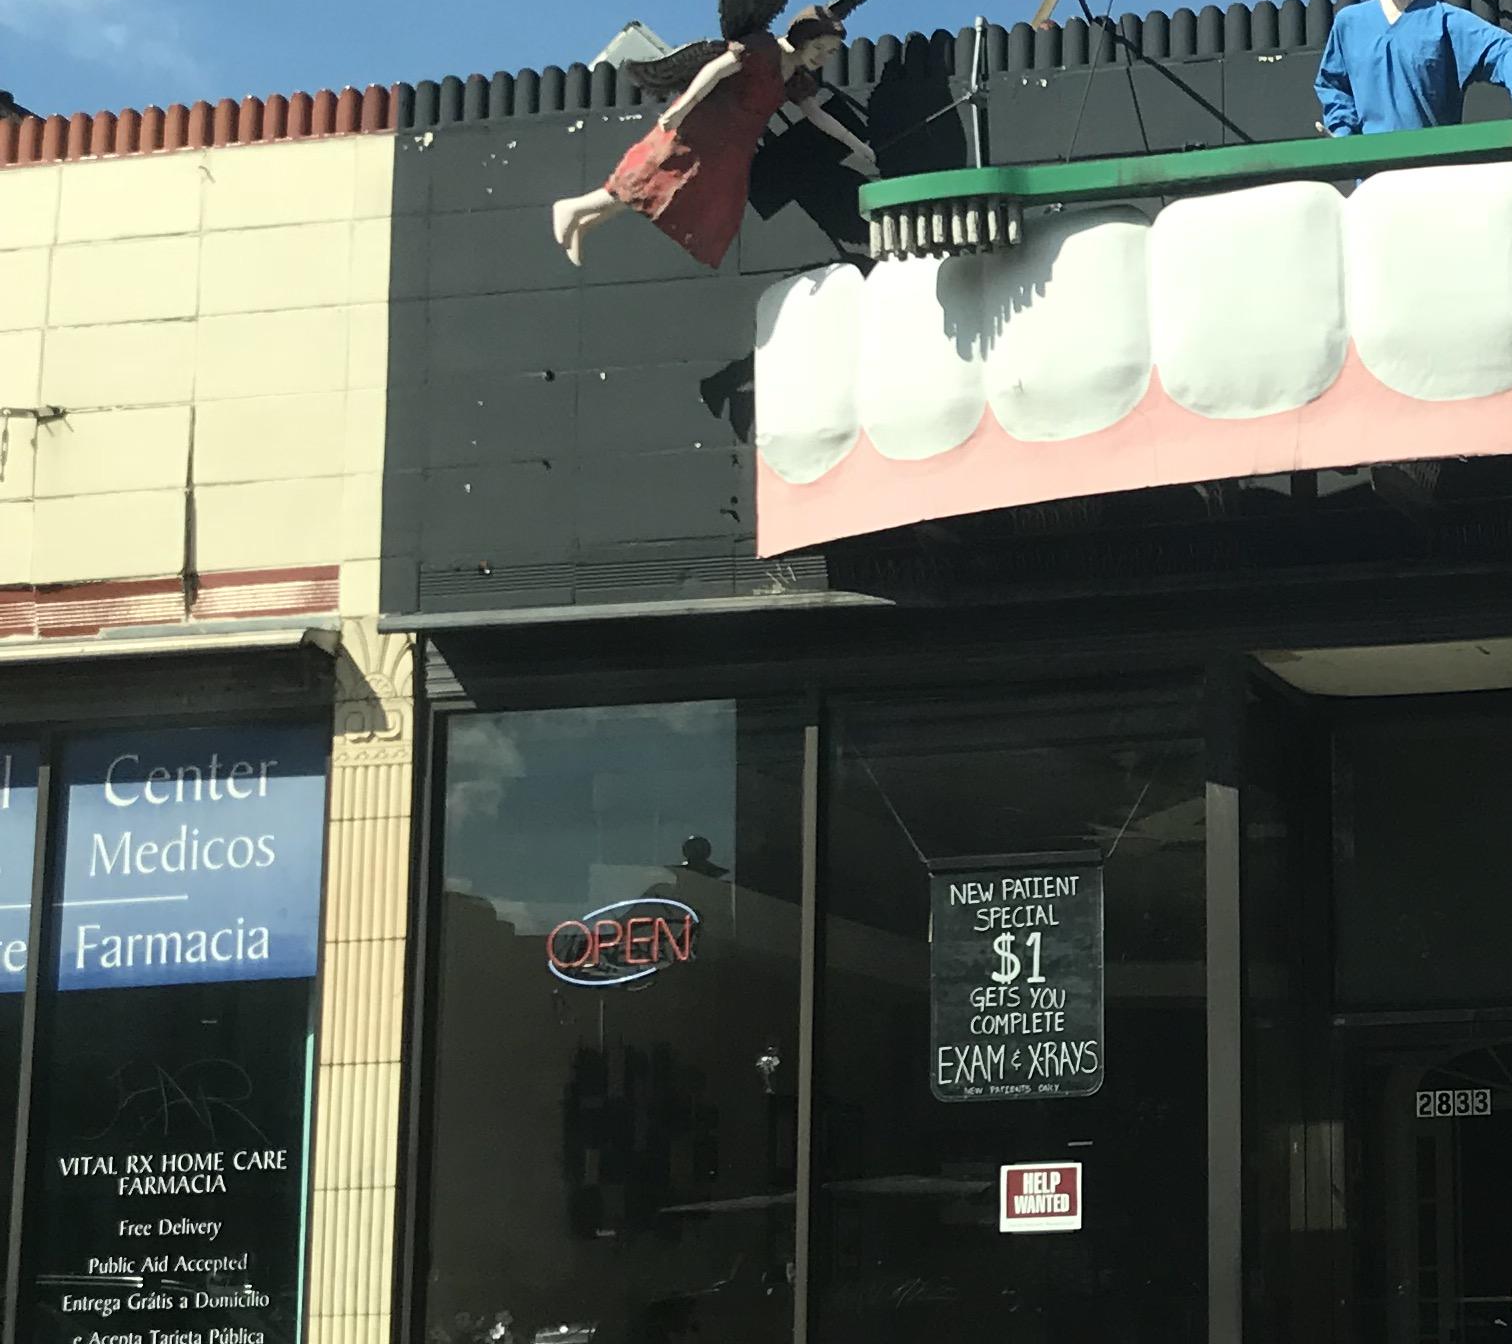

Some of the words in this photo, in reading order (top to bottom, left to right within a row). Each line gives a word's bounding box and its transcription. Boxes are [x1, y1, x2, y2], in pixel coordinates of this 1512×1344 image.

[104, 753, 279, 807] Center
[89, 824, 277, 878] Medicos
[950, 882, 994, 906] NEW
[1002, 876, 1080, 901] PATIENT
[973, 904, 1060, 932] SPECIAL
[75, 917, 270, 970] Farmacia
[546, 913, 693, 969] OPEN
[991, 931, 1046, 985] $1
[969, 986, 1021, 1012] GETS
[1029, 987, 1066, 1010] YOU
[970, 1011, 1065, 1035] COMPLETE
[938, 1043, 1006, 1085] EXAM
[1027, 1040, 1099, 1081] X-RAYS
[1419, 1090, 1489, 1116] 2833
[59, 1156, 118, 1176] VITAL
[126, 1154, 153, 1174] RX
[161, 1151, 225, 1173] HOME
[233, 1149, 287, 1171] CARE
[118, 1174, 227, 1196] FARMACIA
[1022, 1171, 1062, 1195] HELP
[1013, 1193, 1070, 1215] WANTED
[118, 1219, 152, 1237] Free
[158, 1217, 222, 1241] Delivery
[88, 1256, 135, 1275] Public
[140, 1255, 169, 1274] Aid
[174, 1253, 248, 1276] Accepted
[62, 1294, 121, 1317] Entrega
[127, 1291, 174, 1311] Grátis
[179, 1295, 188, 1309] a
[195, 1290, 270, 1309] Domicilio
